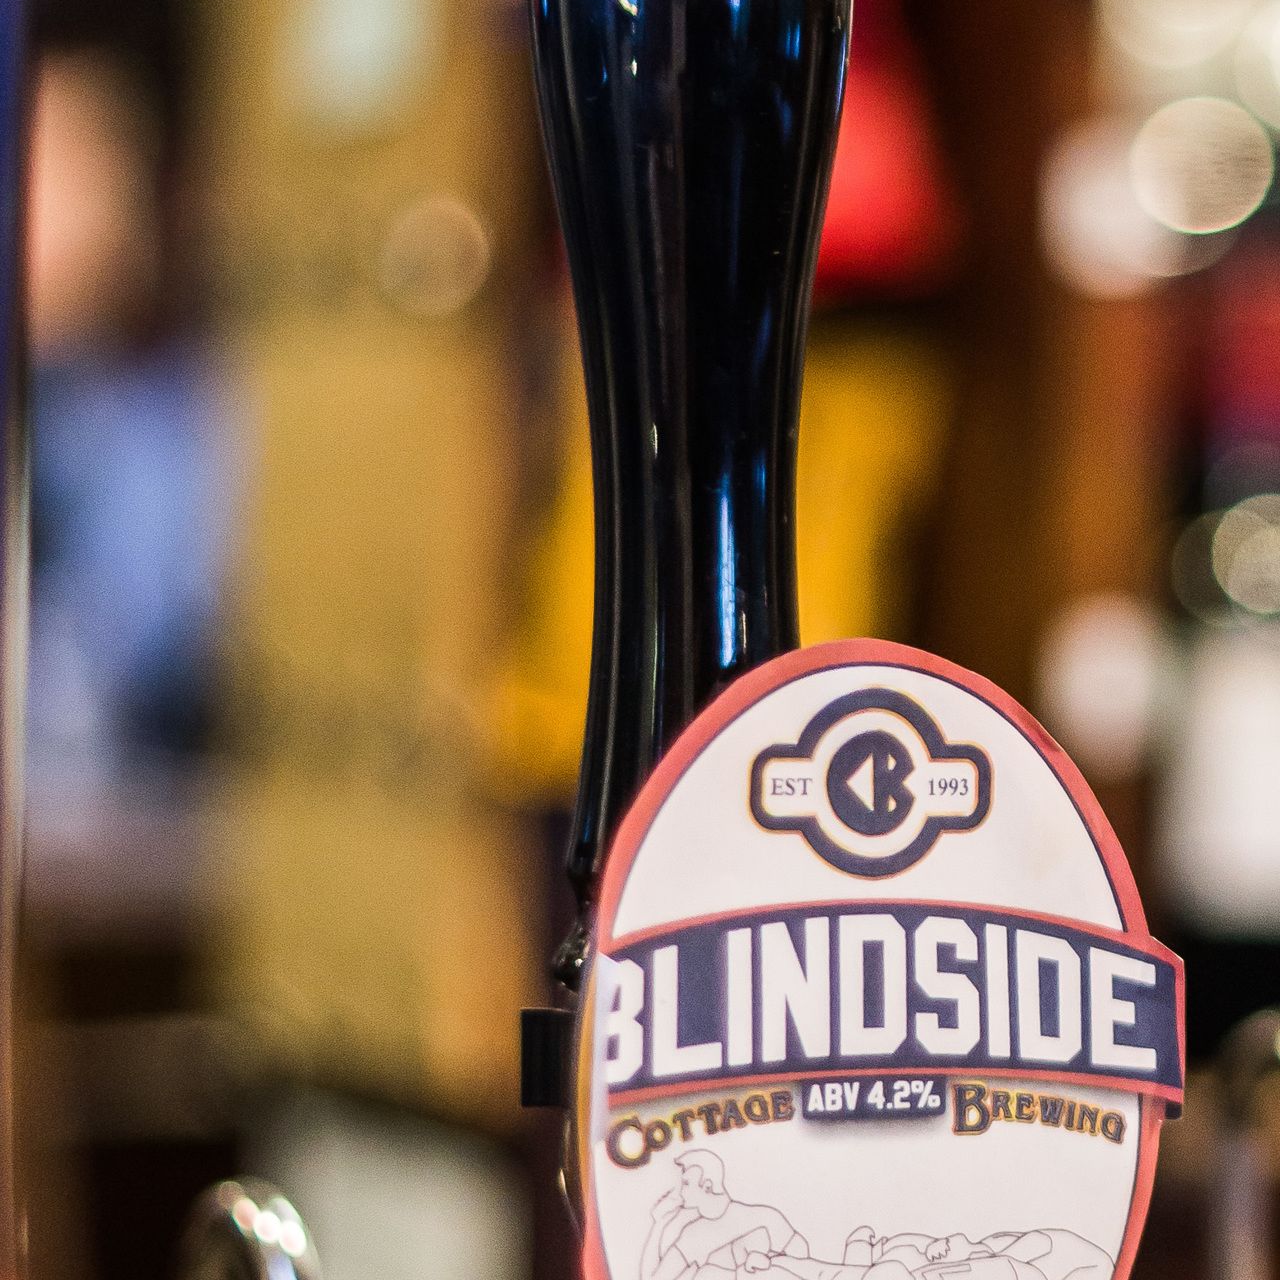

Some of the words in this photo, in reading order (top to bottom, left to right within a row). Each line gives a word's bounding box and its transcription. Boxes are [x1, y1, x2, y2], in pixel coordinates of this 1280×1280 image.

[770, 777, 813, 797] EST
[927, 777, 970, 798] 1993
[601, 914, 1158, 1084] BLINDSIDE
[807, 1081, 859, 1113] ABV
[866, 1079, 943, 1112] 4.2%
